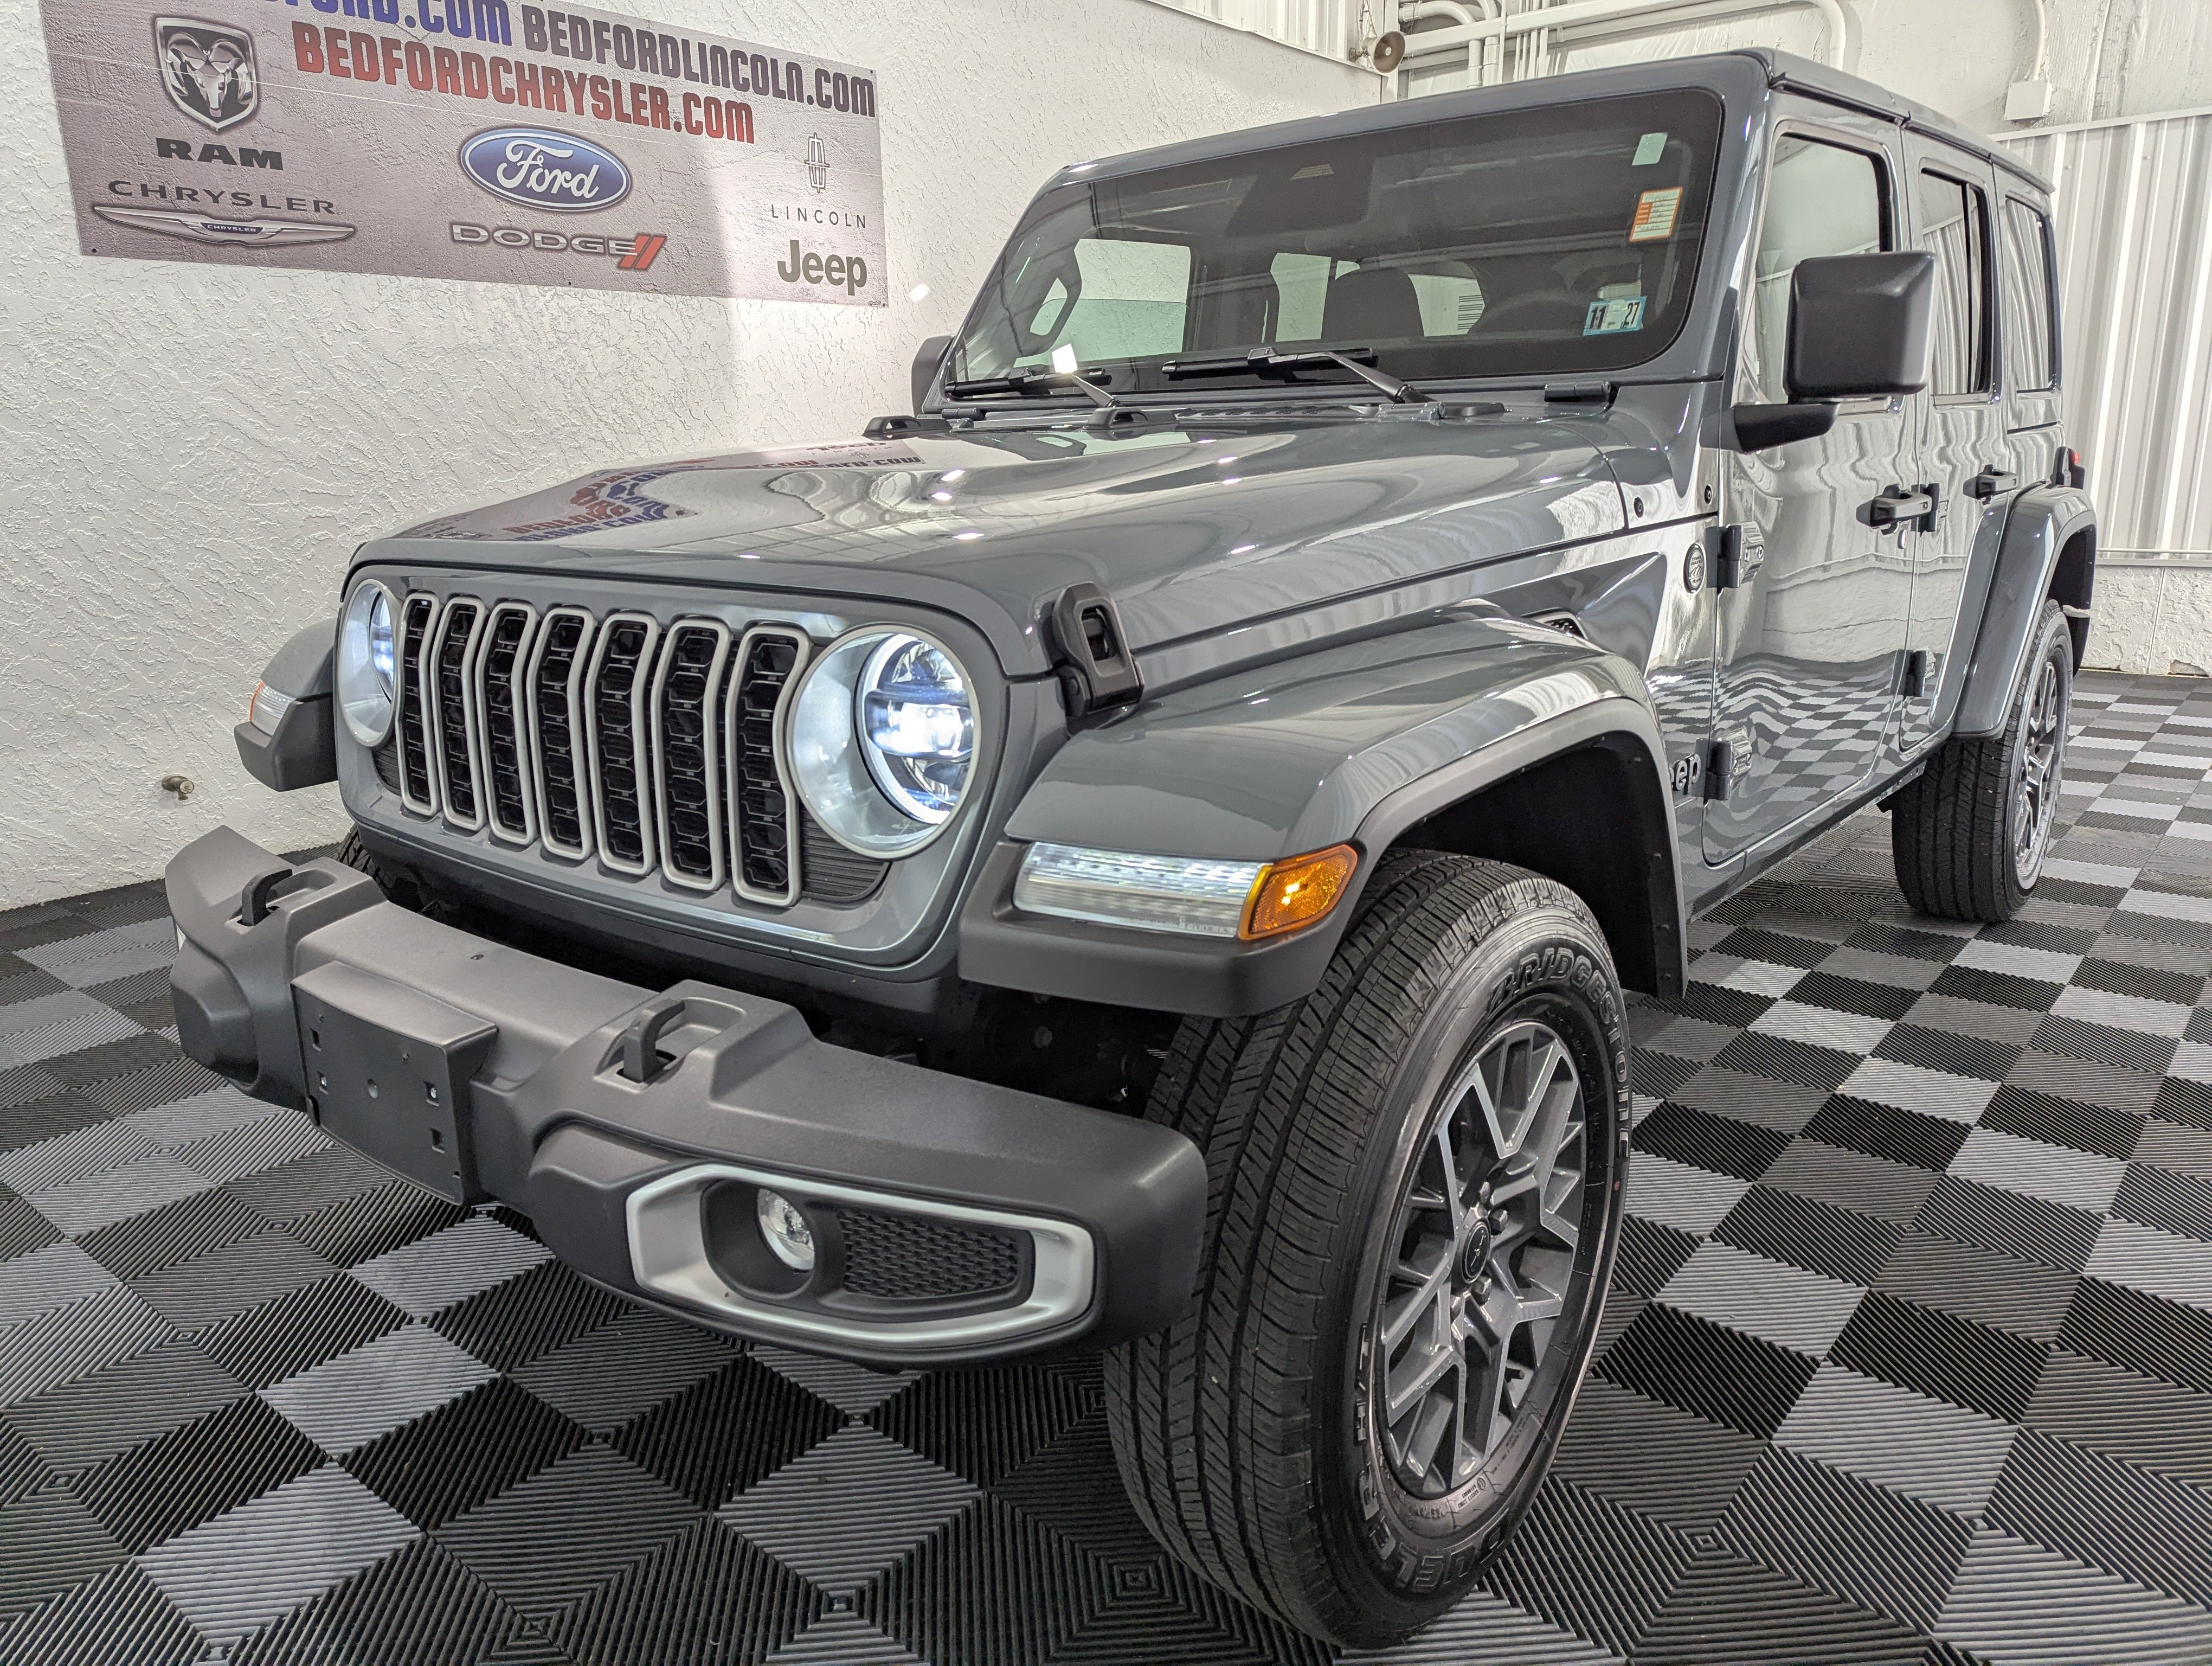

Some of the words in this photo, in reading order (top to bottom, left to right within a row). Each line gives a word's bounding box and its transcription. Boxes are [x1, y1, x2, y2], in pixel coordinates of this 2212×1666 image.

[522, 5, 876, 118] BEDFORDLINCOLN.COM
[292, 21, 755, 144] BEDFORDCHRYSLER.COM
[156, 137, 284, 171] RAM
[497, 139, 600, 200] Ford
[108, 180, 336, 214] CHRYSLER
[207, 225, 256, 233] CHRYSLER
[771, 204, 866, 229] LINCOLN
[452, 224, 638, 256] DODGE
[777, 239, 867, 296] Jeep
